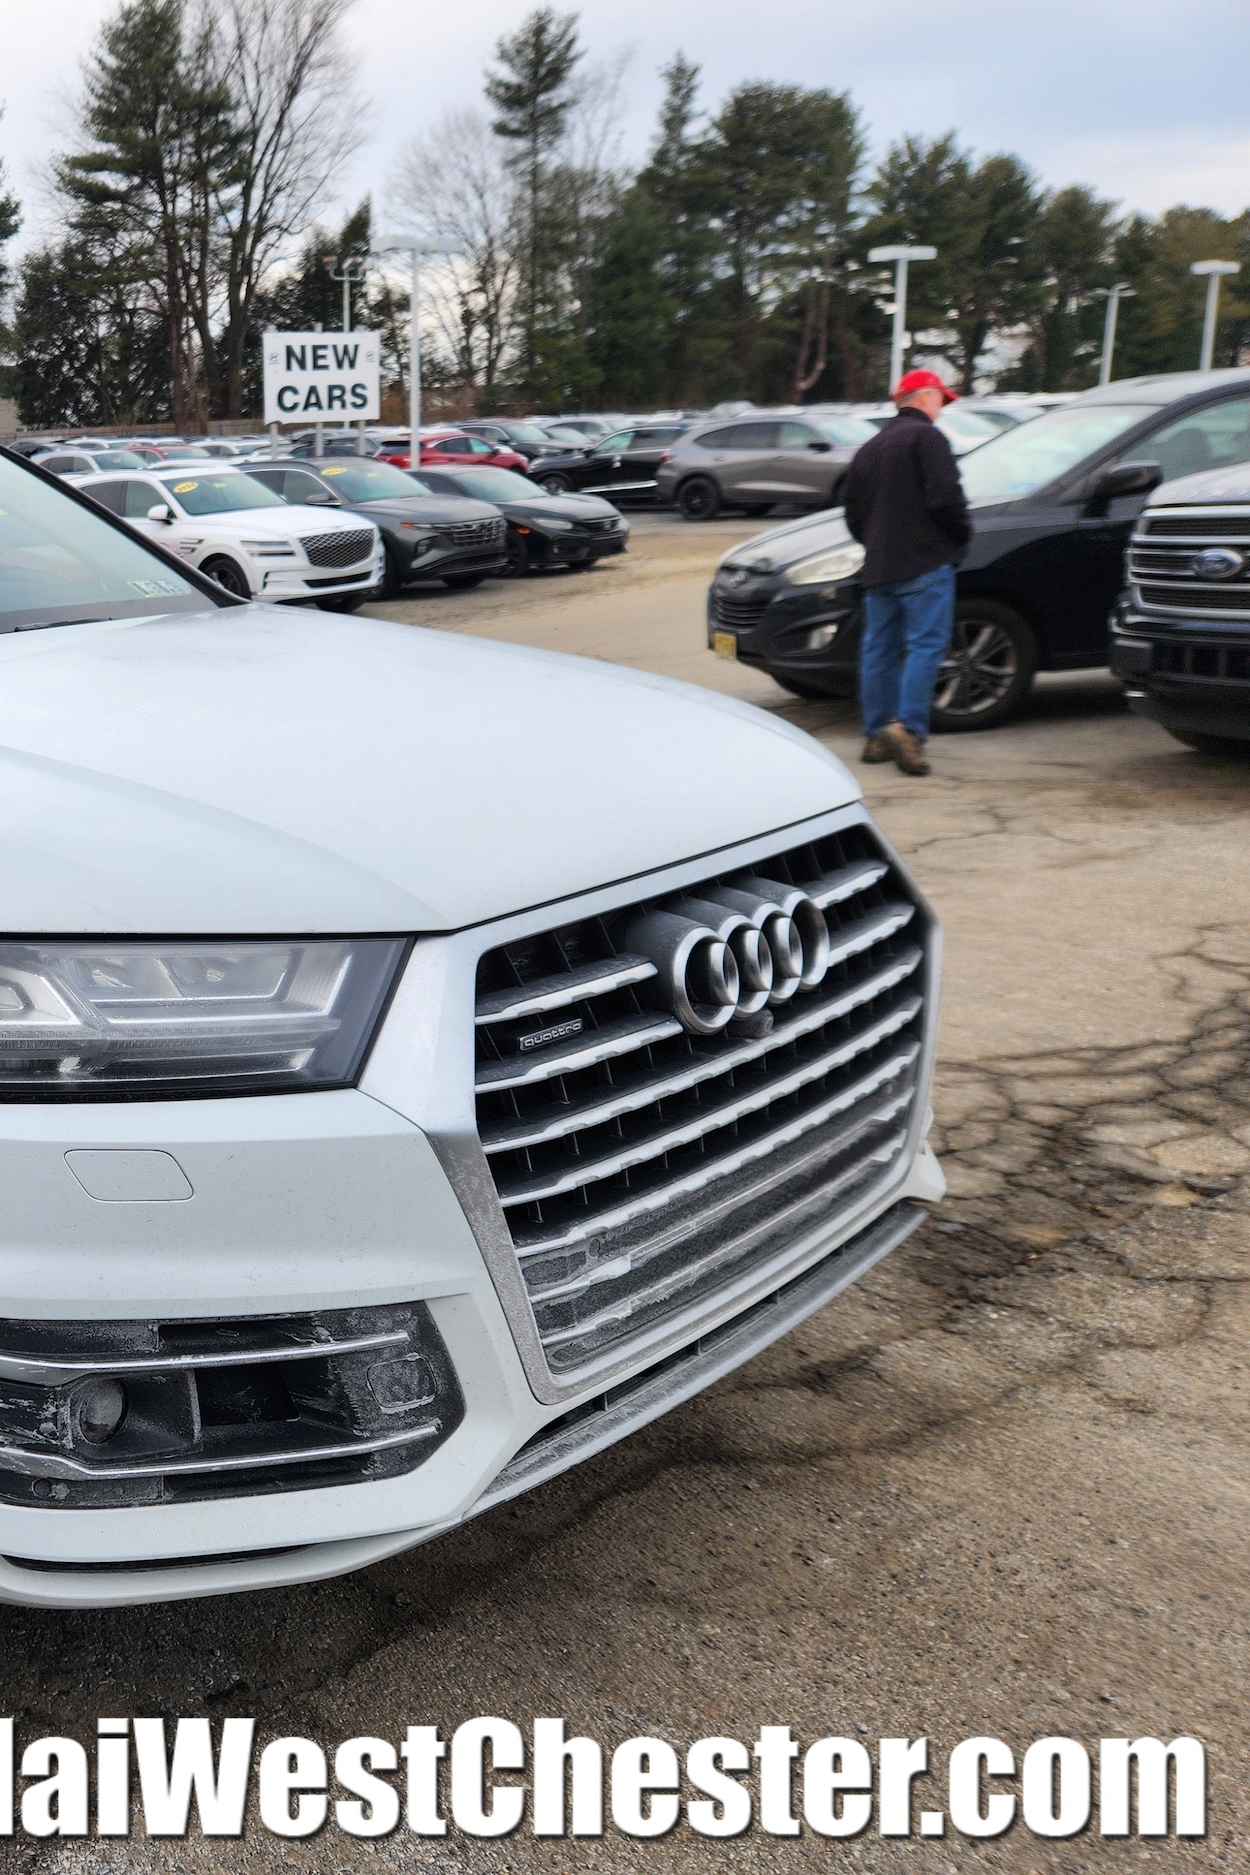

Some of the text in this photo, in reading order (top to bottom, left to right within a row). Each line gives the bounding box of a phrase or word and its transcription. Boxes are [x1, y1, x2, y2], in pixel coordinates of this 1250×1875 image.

[285, 344, 360, 371] NEW
[277, 383, 368, 413] CARS
[524, 1022, 581, 1047] quattro
